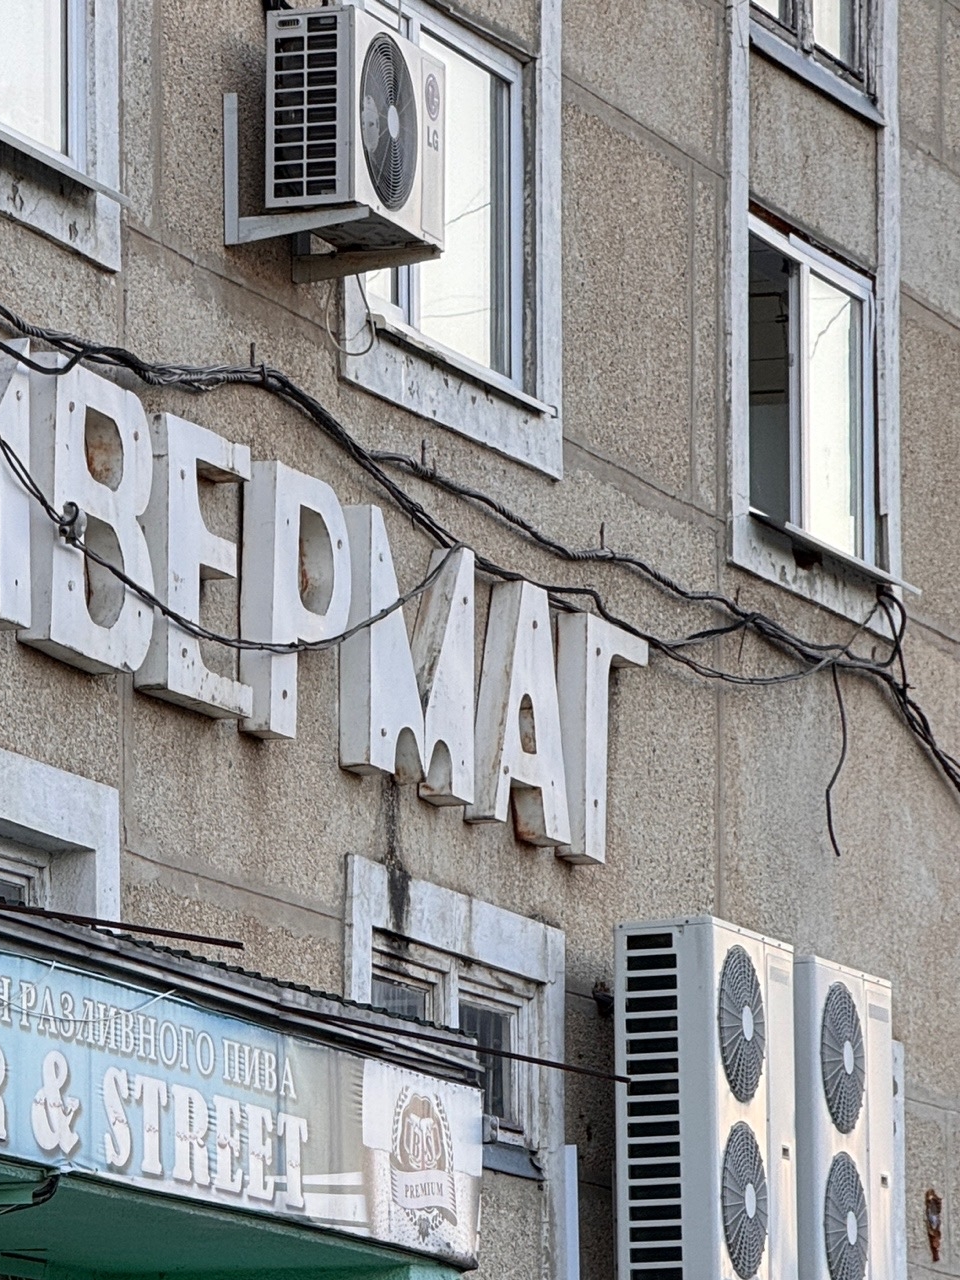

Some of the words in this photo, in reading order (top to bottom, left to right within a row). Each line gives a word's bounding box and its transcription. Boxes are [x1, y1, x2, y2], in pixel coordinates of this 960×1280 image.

[426, 125, 439, 152] LG
[19, 980, 215, 1076] РАЗЛИВНОГО
[222, 1038, 297, 1100] ПИВА
[31, 1050, 81, 1153] &
[102, 1066, 309, 1209] STREET
[404, 1182, 444, 1199] PREMIUM
